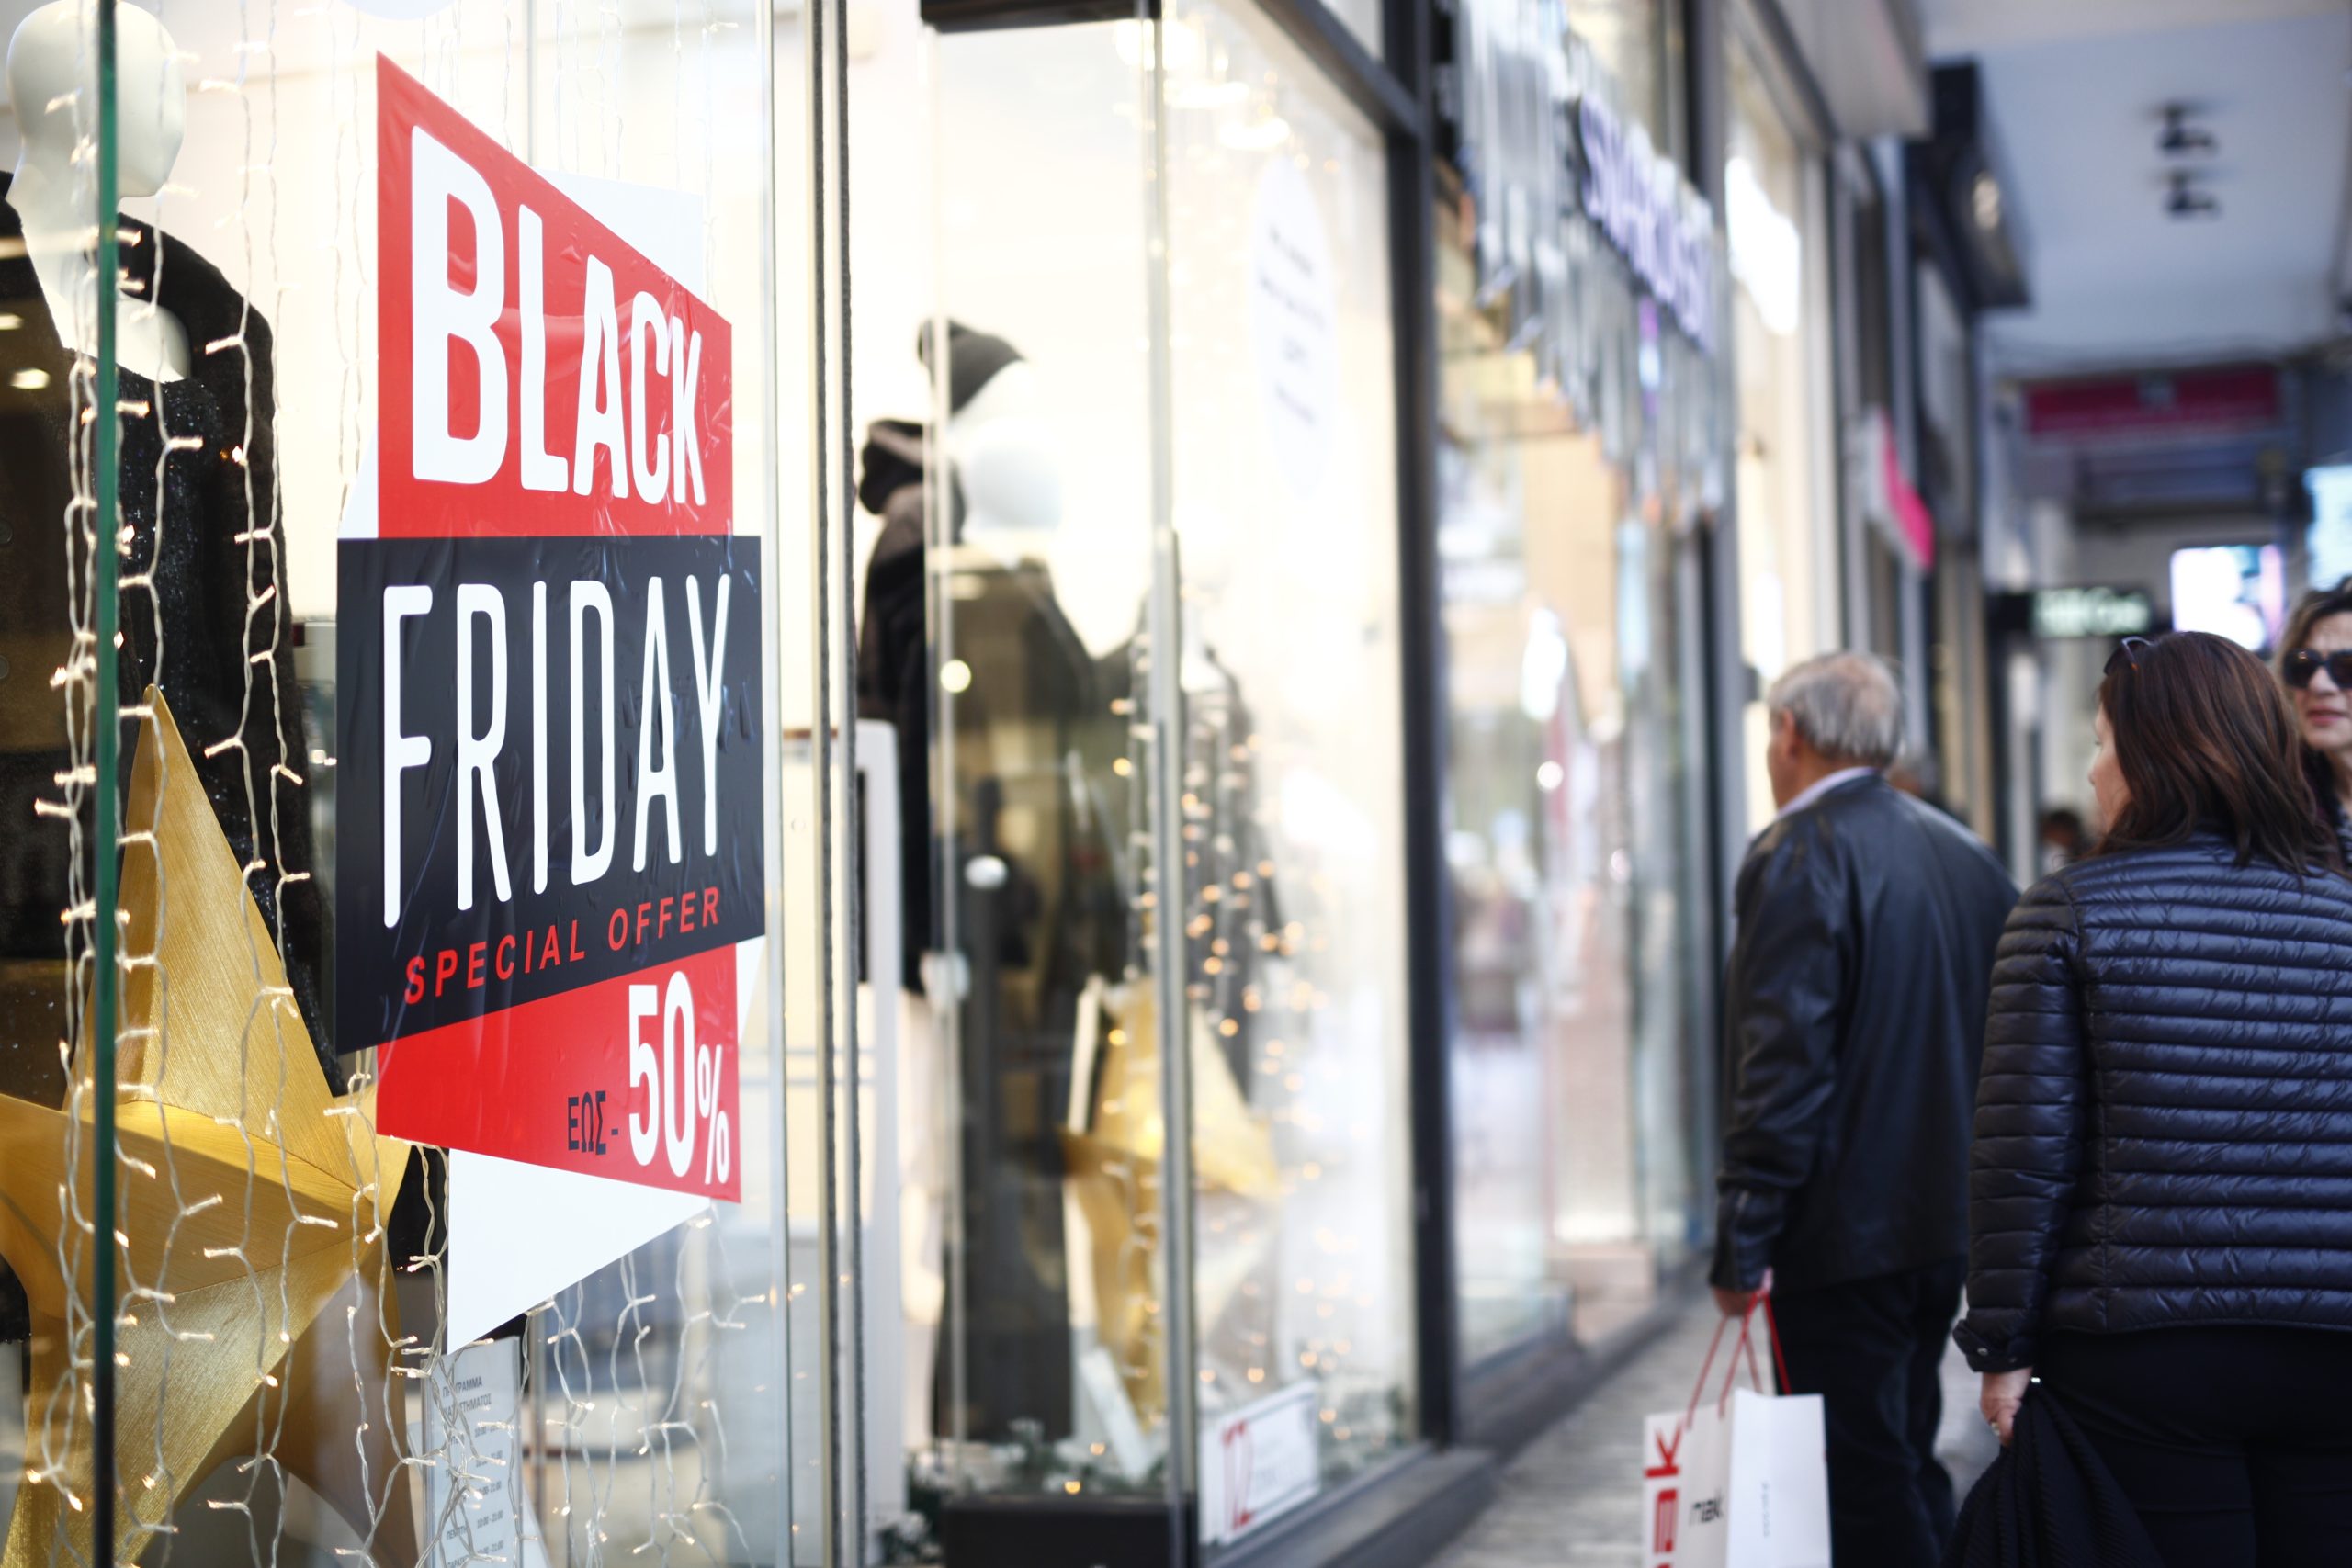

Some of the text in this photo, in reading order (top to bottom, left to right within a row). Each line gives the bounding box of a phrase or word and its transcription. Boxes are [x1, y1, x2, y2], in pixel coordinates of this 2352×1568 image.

[411, 125, 706, 506] BLACK
[384, 574, 730, 929] FRIDAY
[404, 886, 718, 1005] SPECIAL OFFER
